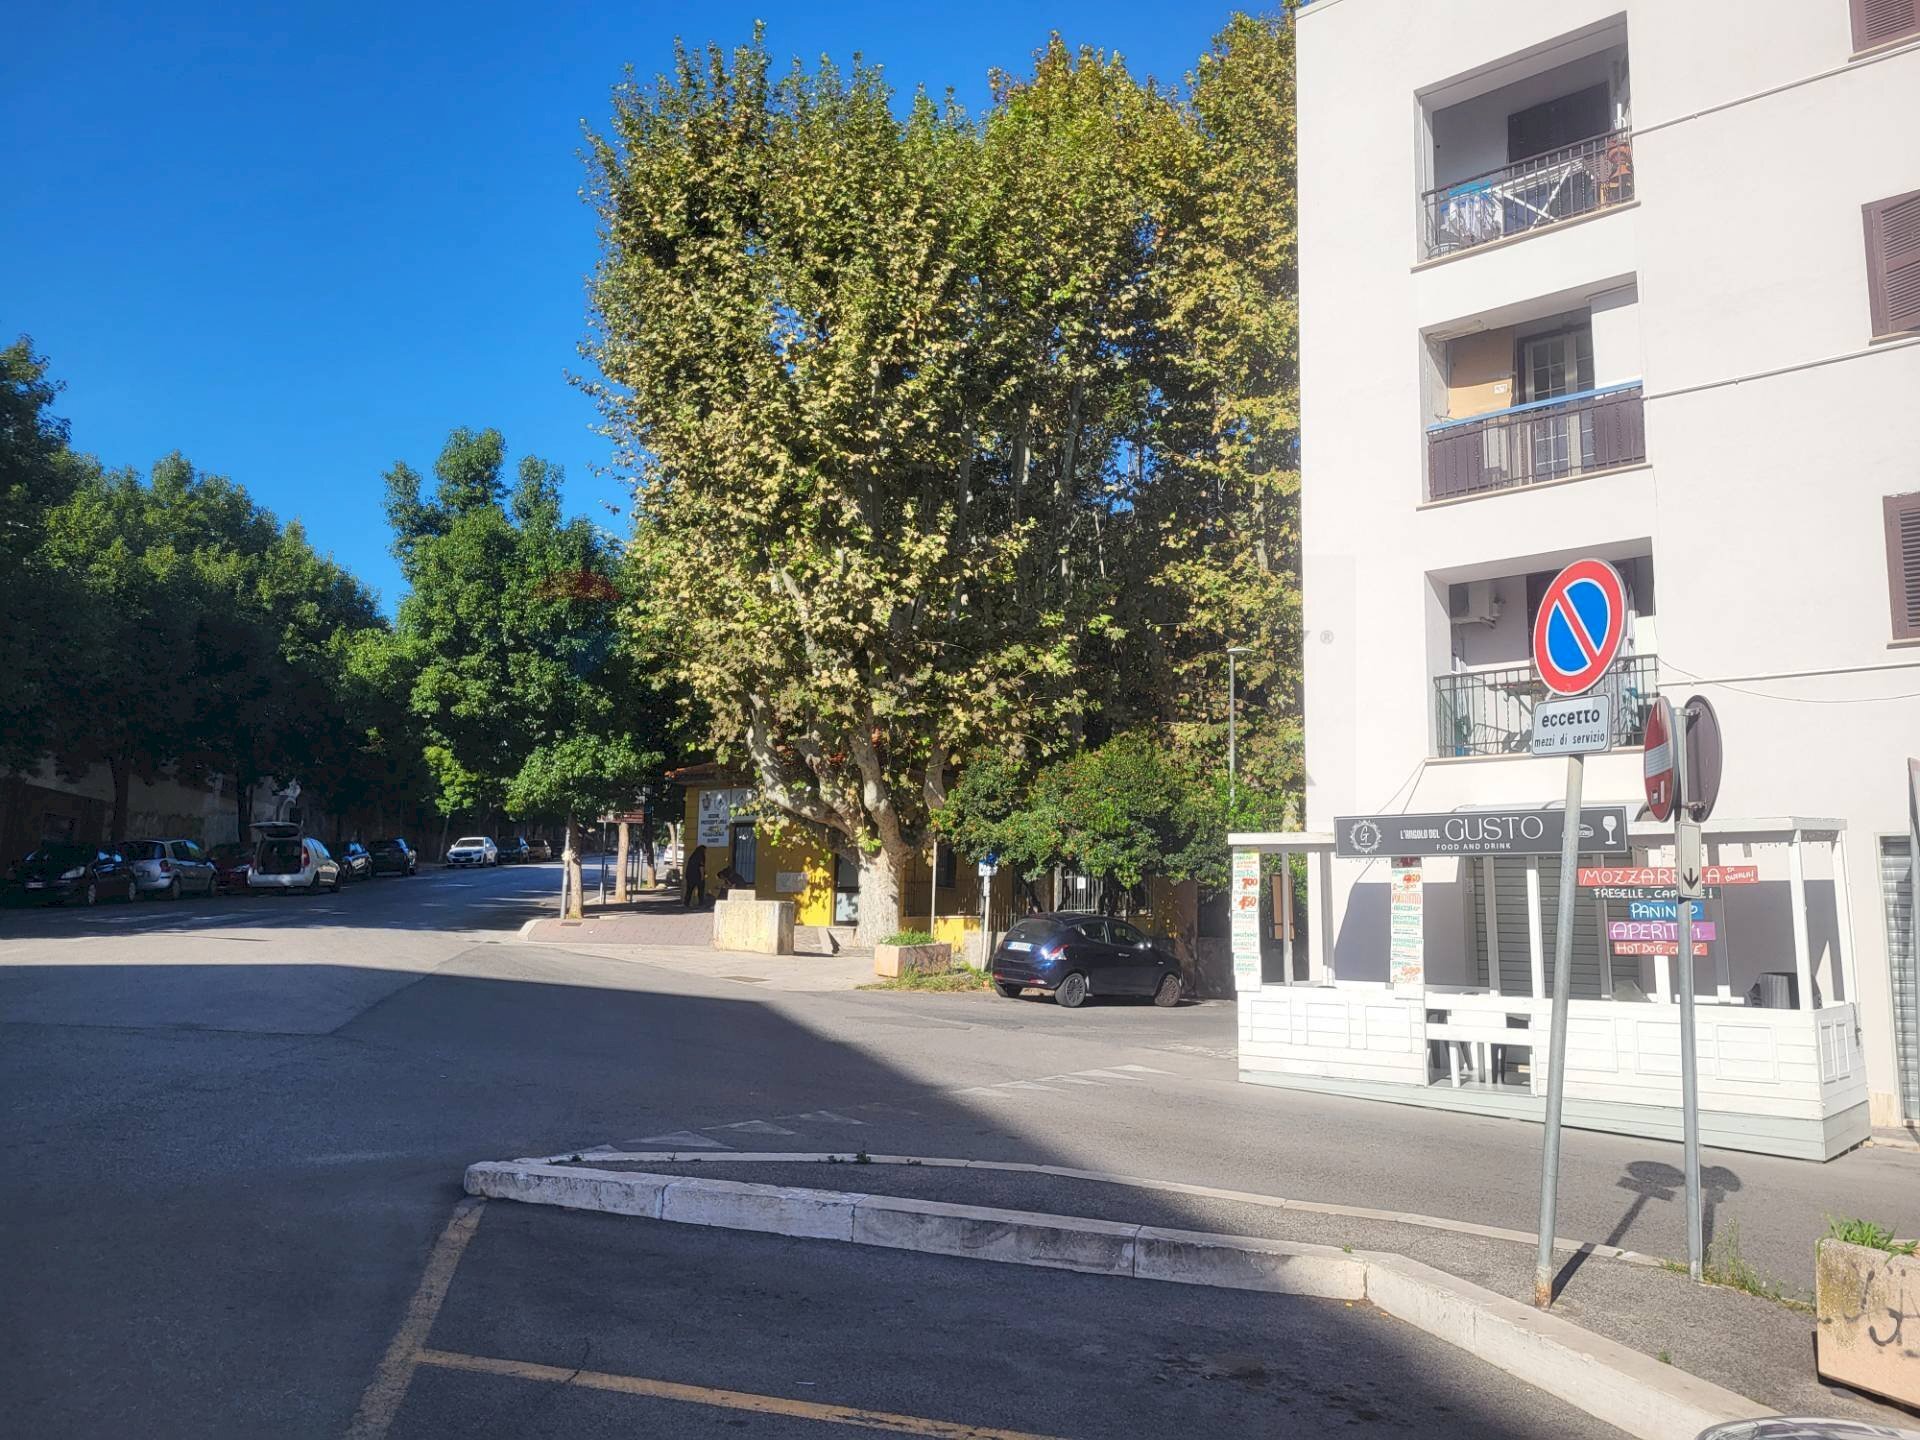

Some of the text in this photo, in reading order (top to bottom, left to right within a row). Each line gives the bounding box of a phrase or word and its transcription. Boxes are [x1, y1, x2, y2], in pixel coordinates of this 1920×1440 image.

[1541, 709, 1600, 728] eccetto
[1534, 729, 1605, 748] mezzi di servizio
[1429, 828, 1441, 839] DEL
[1444, 815, 1544, 841] GUSTO
[1436, 842, 1511, 851] FOOD AND DRINK
[1583, 868, 1720, 886] MOZZAREA
[1594, 887, 1645, 899] FRESELLE
[1611, 921, 1701, 940] APERITI
